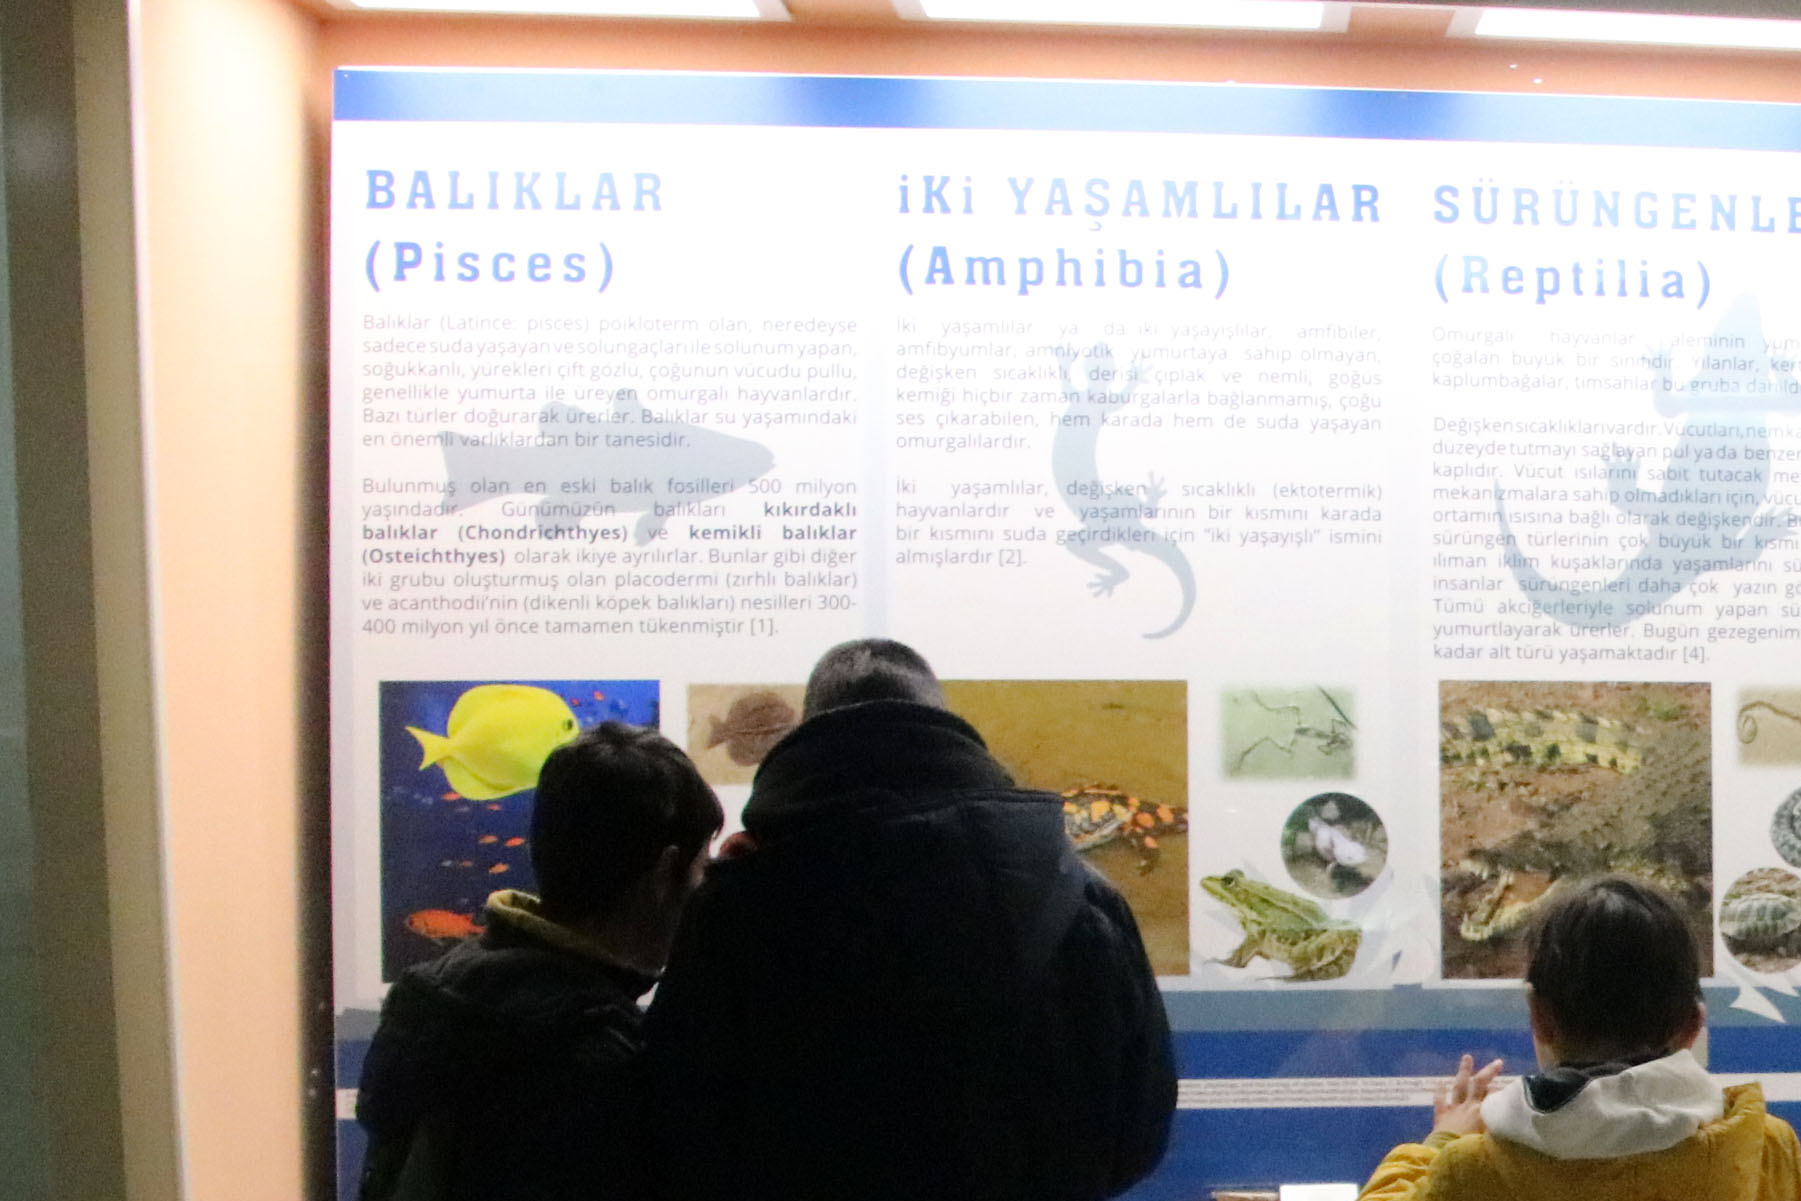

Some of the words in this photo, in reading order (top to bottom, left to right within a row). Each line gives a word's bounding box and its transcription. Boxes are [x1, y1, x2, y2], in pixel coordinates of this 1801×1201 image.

[365, 168, 663, 212] BALIKLAR
[1008, 176, 1382, 231] YAŞAMLILAR
[364, 240, 615, 294] (Pisces)
[898, 244, 1231, 300] (Amphibia)
[1434, 253, 1713, 310] (Reptilia)
[362, 477, 457, 497] Bulunmuş
[470, 477, 509, 493] olan
[524, 481, 546, 494] en
[560, 478, 597, 494] eski
[609, 478, 654, 494] balık
[667, 478, 734, 494] fosilleri
[749, 479, 782, 494] 500
[795, 478, 857, 498] milyon
[896, 478, 917, 494] İki
[950, 479, 1049, 500] yaşamlılar,
[1066, 480, 1147, 501] değişken
[1181, 481, 1256, 498] sıcaklıklı
[1272, 482, 1383, 502] (ektotermik)
[653, 501, 726, 517] balıkları
[763, 501, 857, 517] kıkırdaklı
[895, 501, 1011, 522] hayvanlardır
[1033, 506, 1056, 519] ve
[1080, 503, 1196, 524] yaşamlarının
[1208, 504, 1233, 520] bir
[1244, 504, 1308, 521] kısmını
[1320, 505, 1383, 521] karada
[362, 524, 439, 540] balıklar
[457, 524, 629, 544] (Chondrichthyes)
[648, 528, 668, 540] ve
[688, 524, 762, 540] kemikli
[782, 525, 858, 541] balıklar
[895, 524, 921, 540] bir
[929, 525, 995, 541] kısmını
[1002, 525, 1047, 541] suda
[1164, 527, 1197, 547] için
[1329, 528, 1383, 544] ismini
[1432, 529, 1517, 550] sürüngen
[1527, 531, 1609, 548] türlerinin
[1618, 532, 1653, 552] çok
[1658, 532, 1712, 553] büyük
[1721, 533, 1745, 550] bir
[361, 548, 506, 567] (Osteichthyes)
[514, 548, 571, 563] olarak
[576, 548, 617, 567] ikiye
[621, 548, 703, 567] ayrılırlar.
[708, 548, 769, 563] Bunlar
[772, 548, 806, 567] gibi
[810, 548, 857, 567] diğer
[895, 548, 994, 568] almışlardır
[997, 548, 1028, 567] [2].
[1432, 551, 1487, 568] ılıman
[1498, 552, 1540, 569] iklim
[1550, 553, 1663, 575] kuşaklarında
[1672, 555, 1773, 577] yaşamlarını
[362, 571, 382, 587] iki
[389, 571, 445, 591] grubu
[453, 571, 560, 591] oluşturmuş
[566, 571, 607, 587] olan
[614, 571, 719, 591] placodermi
[725, 571, 776, 590] (zırhlı
[784, 571, 859, 590] balıklar)
[1432, 575, 1504, 591] insanlar
[1520, 576, 1631, 597] sürüngenleri
[1637, 577, 1681, 594] daha
[1687, 578, 1719, 598] çok
[1732, 582, 1778, 599] yazın
[361, 599, 384, 611] ve
[522, 595, 590, 613] (dikenli
[656, 594, 736, 613] balıkları)
[740, 594, 812, 610] nesilleri
[817, 595, 857, 610] 300-
[1431, 597, 1485, 614] Tümü
[1497, 598, 1614, 619] akciğerleriyle
[1625, 600, 1703, 616] solunum
[1715, 605, 1768, 621] yapan
[361, 618, 397, 634] 400
[401, 618, 464, 638] milyon
[468, 618, 490, 637] yıl
[494, 618, 540, 633] önce
[544, 619, 634, 633] tamamen
[639, 617, 745, 637] tükenmiştir
[749, 617, 779, 636] [1].
[1432, 620, 1562, 641] yumurtlayarak
[1643, 623, 1700, 643] Bugün
[1433, 643, 1484, 659] kadar
[1488, 644, 1512, 660] alt
[1558, 644, 1677, 664] yaşamaktadır
[1682, 645, 1710, 664] [4].
